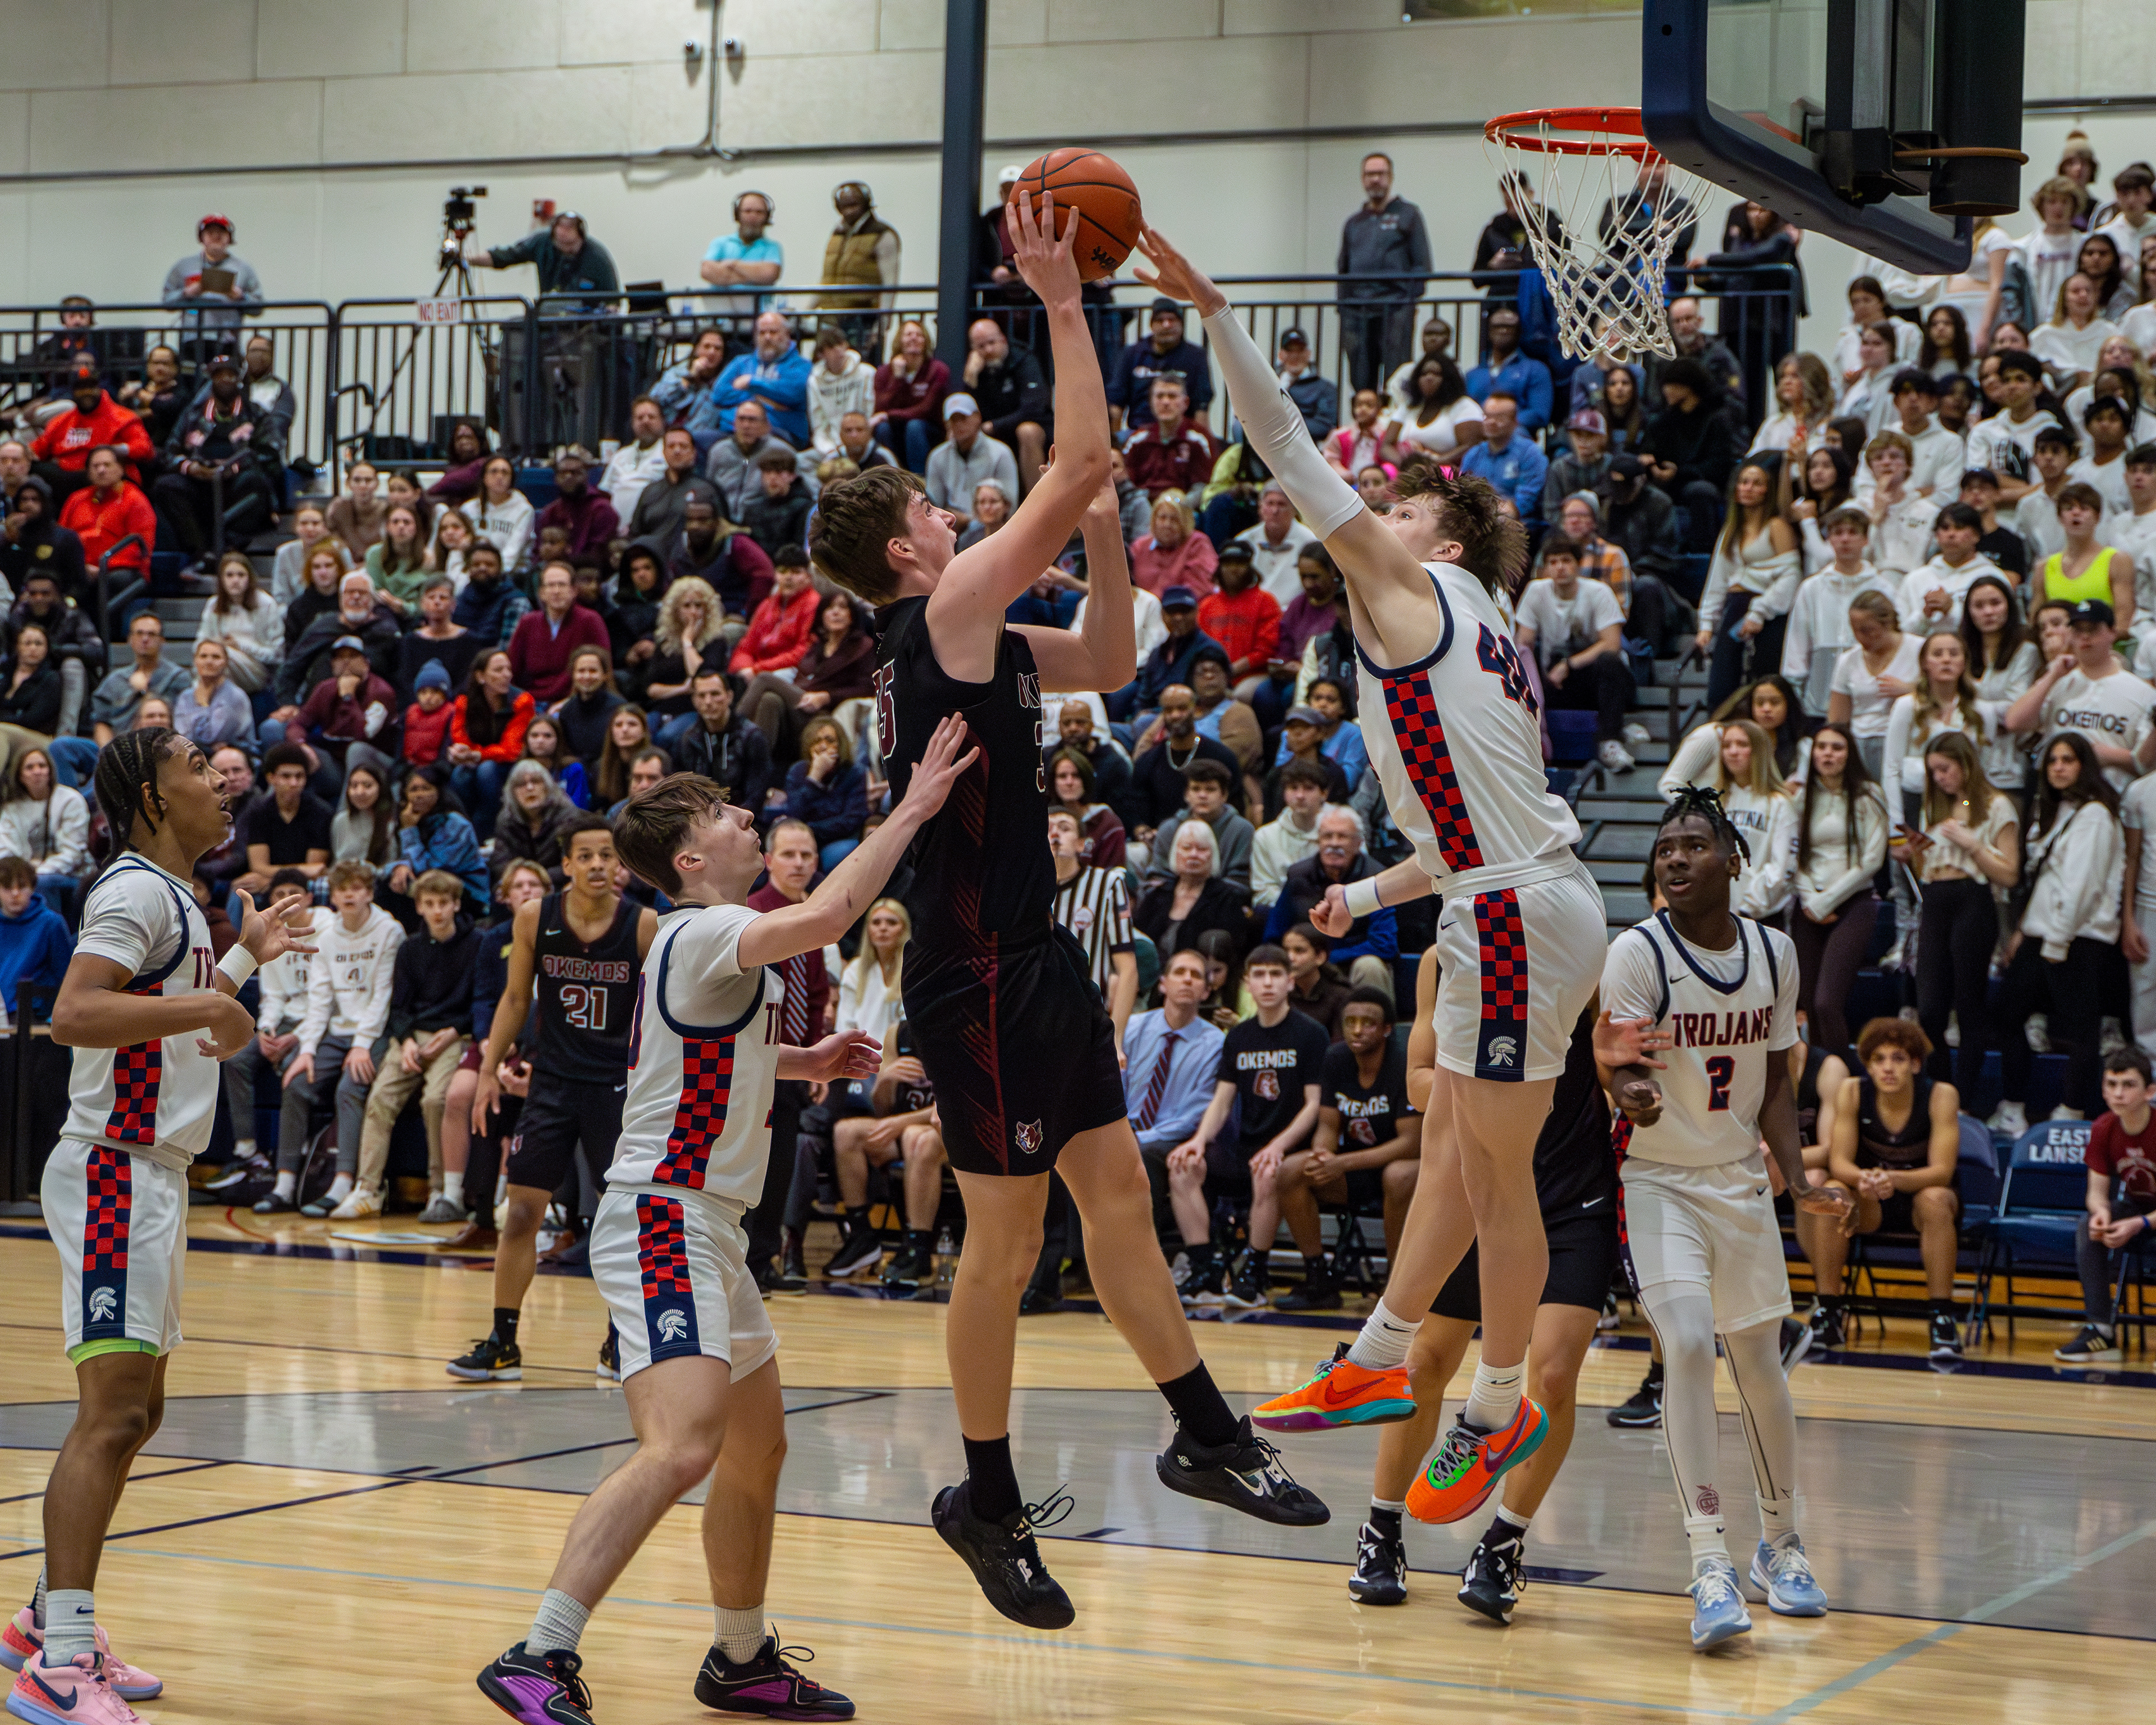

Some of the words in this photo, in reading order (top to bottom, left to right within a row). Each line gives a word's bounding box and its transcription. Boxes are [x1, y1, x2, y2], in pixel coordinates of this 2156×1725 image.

[419, 302, 433, 322] NO
[542, 954, 630, 983] OKEMOS
[559, 984, 608, 1030] 21
[1671, 1005, 1774, 1048] TROJANS
[1236, 1048, 1297, 1071] OKEMOS
[1705, 1055, 1735, 1112] 2
